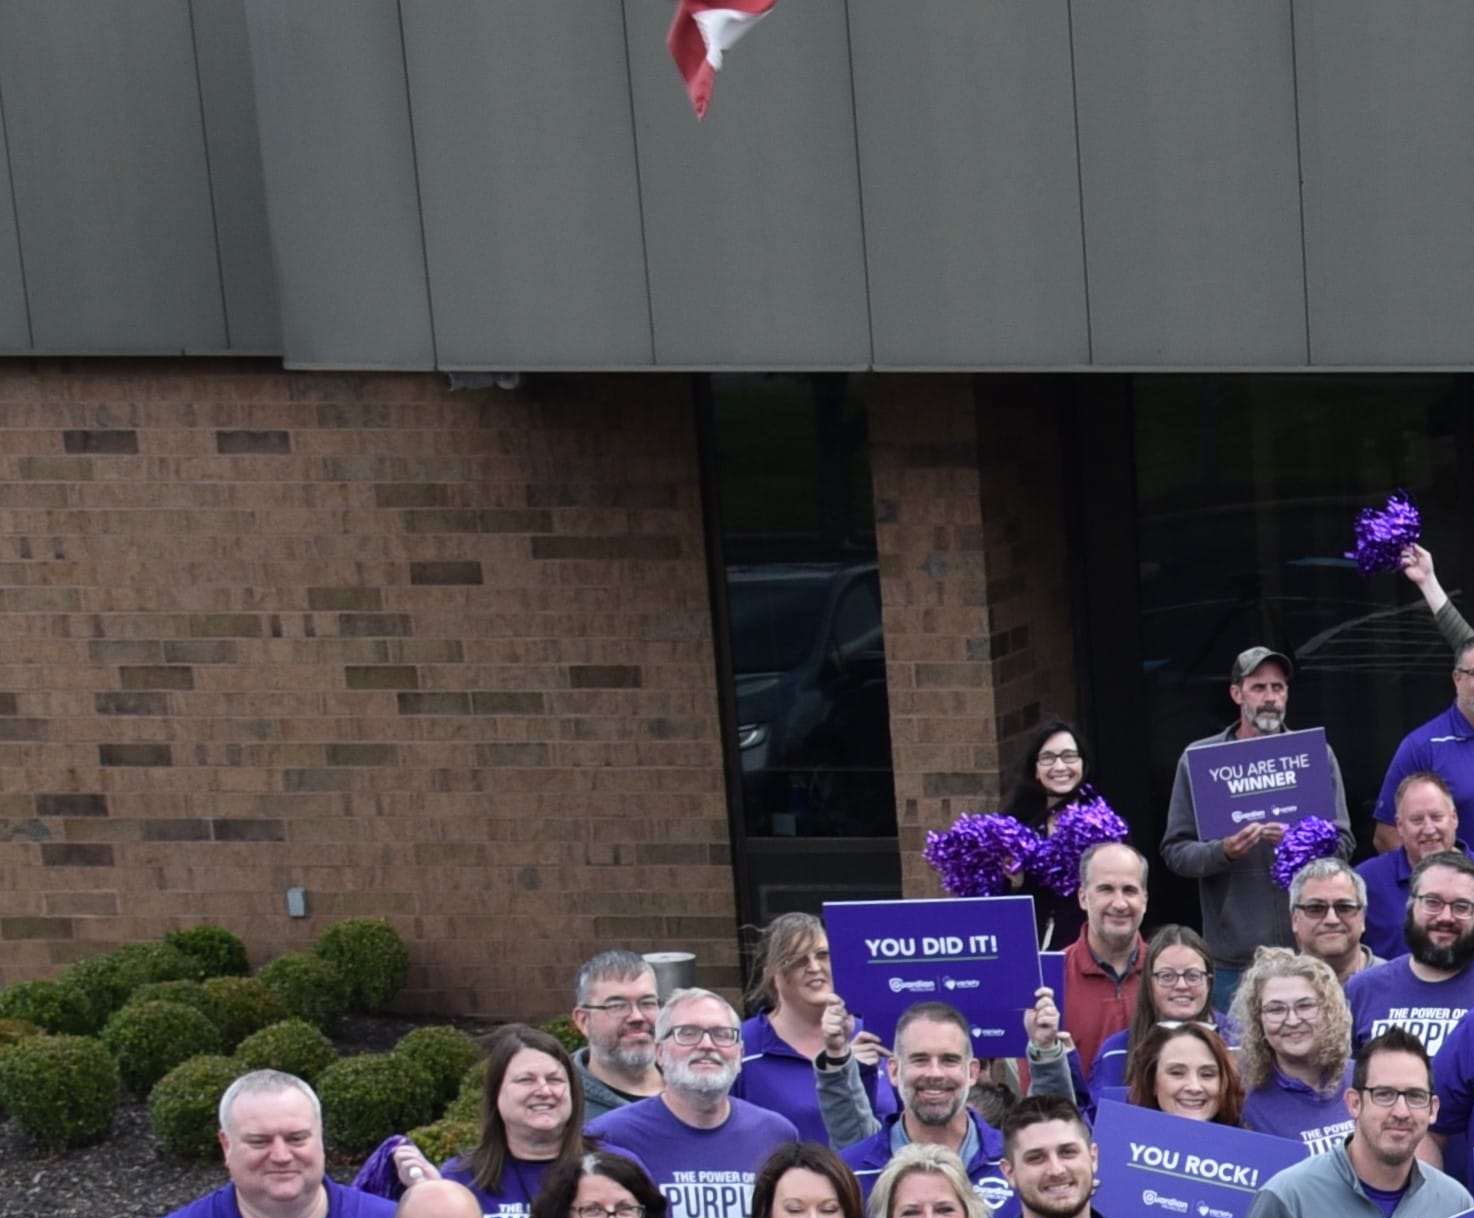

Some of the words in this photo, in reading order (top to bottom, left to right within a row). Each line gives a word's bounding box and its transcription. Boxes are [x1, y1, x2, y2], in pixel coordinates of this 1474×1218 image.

[1209, 763, 1243, 783] YOU
[1247, 758, 1279, 777] ARE
[1279, 753, 1311, 771] THE
[1227, 770, 1298, 794] WINNER
[865, 938, 916, 957] YOU
[922, 936, 963, 955] DID
[969, 935, 998, 953] IT!
[1389, 1008, 1409, 1020] THE
[1410, 1008, 1451, 1020] POWER
[1300, 1128, 1322, 1141] THE
[1129, 1142, 1180, 1169] YOU
[1184, 1154, 1259, 1187] ROCK!
[672, 1171, 697, 1184] THE
[698, 1171, 740, 1184] POWER
[499, 1202, 523, 1214] THE
